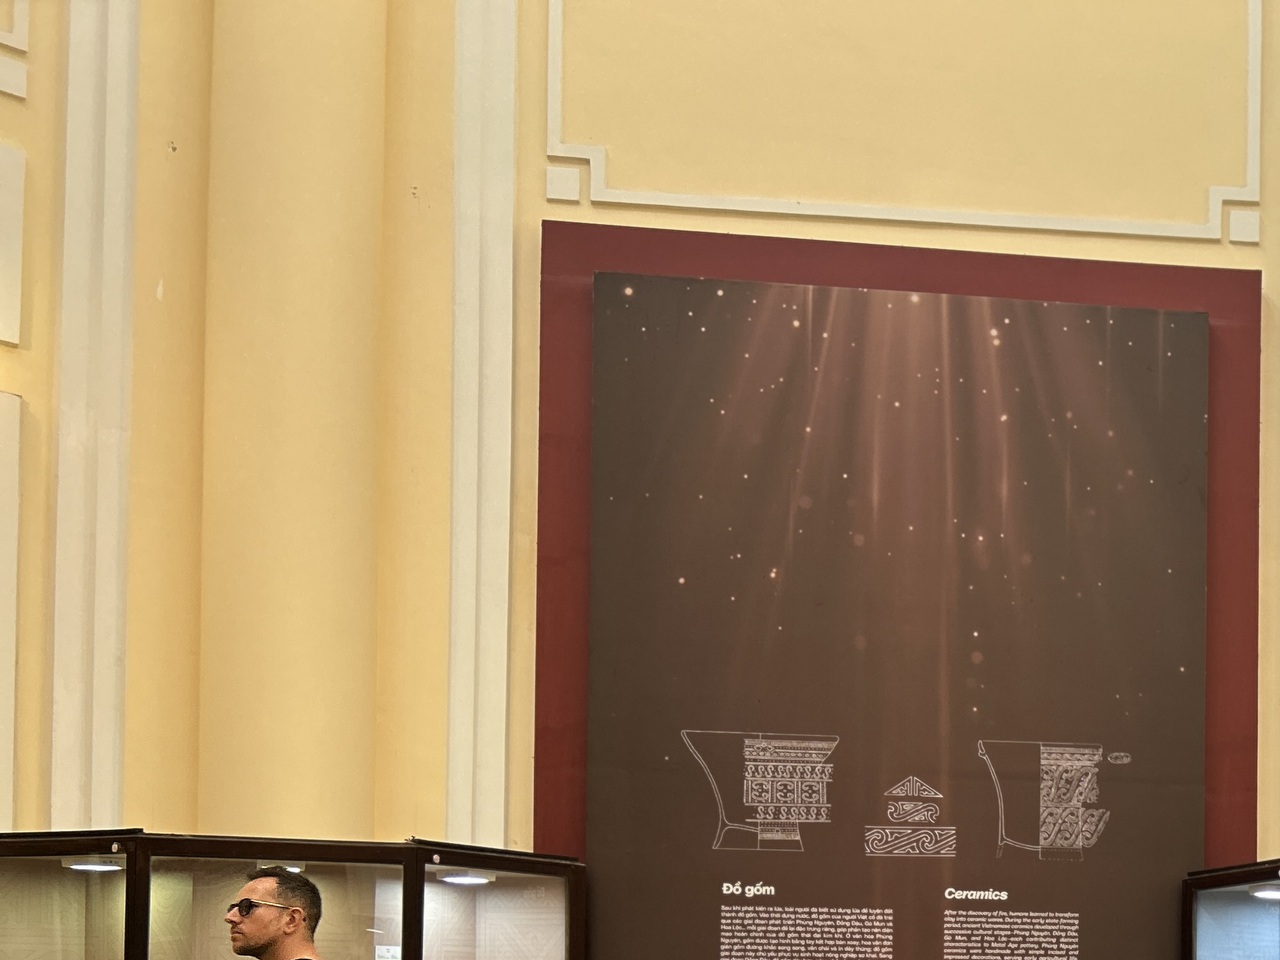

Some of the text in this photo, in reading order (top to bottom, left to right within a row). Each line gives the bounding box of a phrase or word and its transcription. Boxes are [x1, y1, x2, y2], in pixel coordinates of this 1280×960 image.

[722, 881, 775, 897] Đồ gốm
[944, 887, 1008, 900] Ceramics
